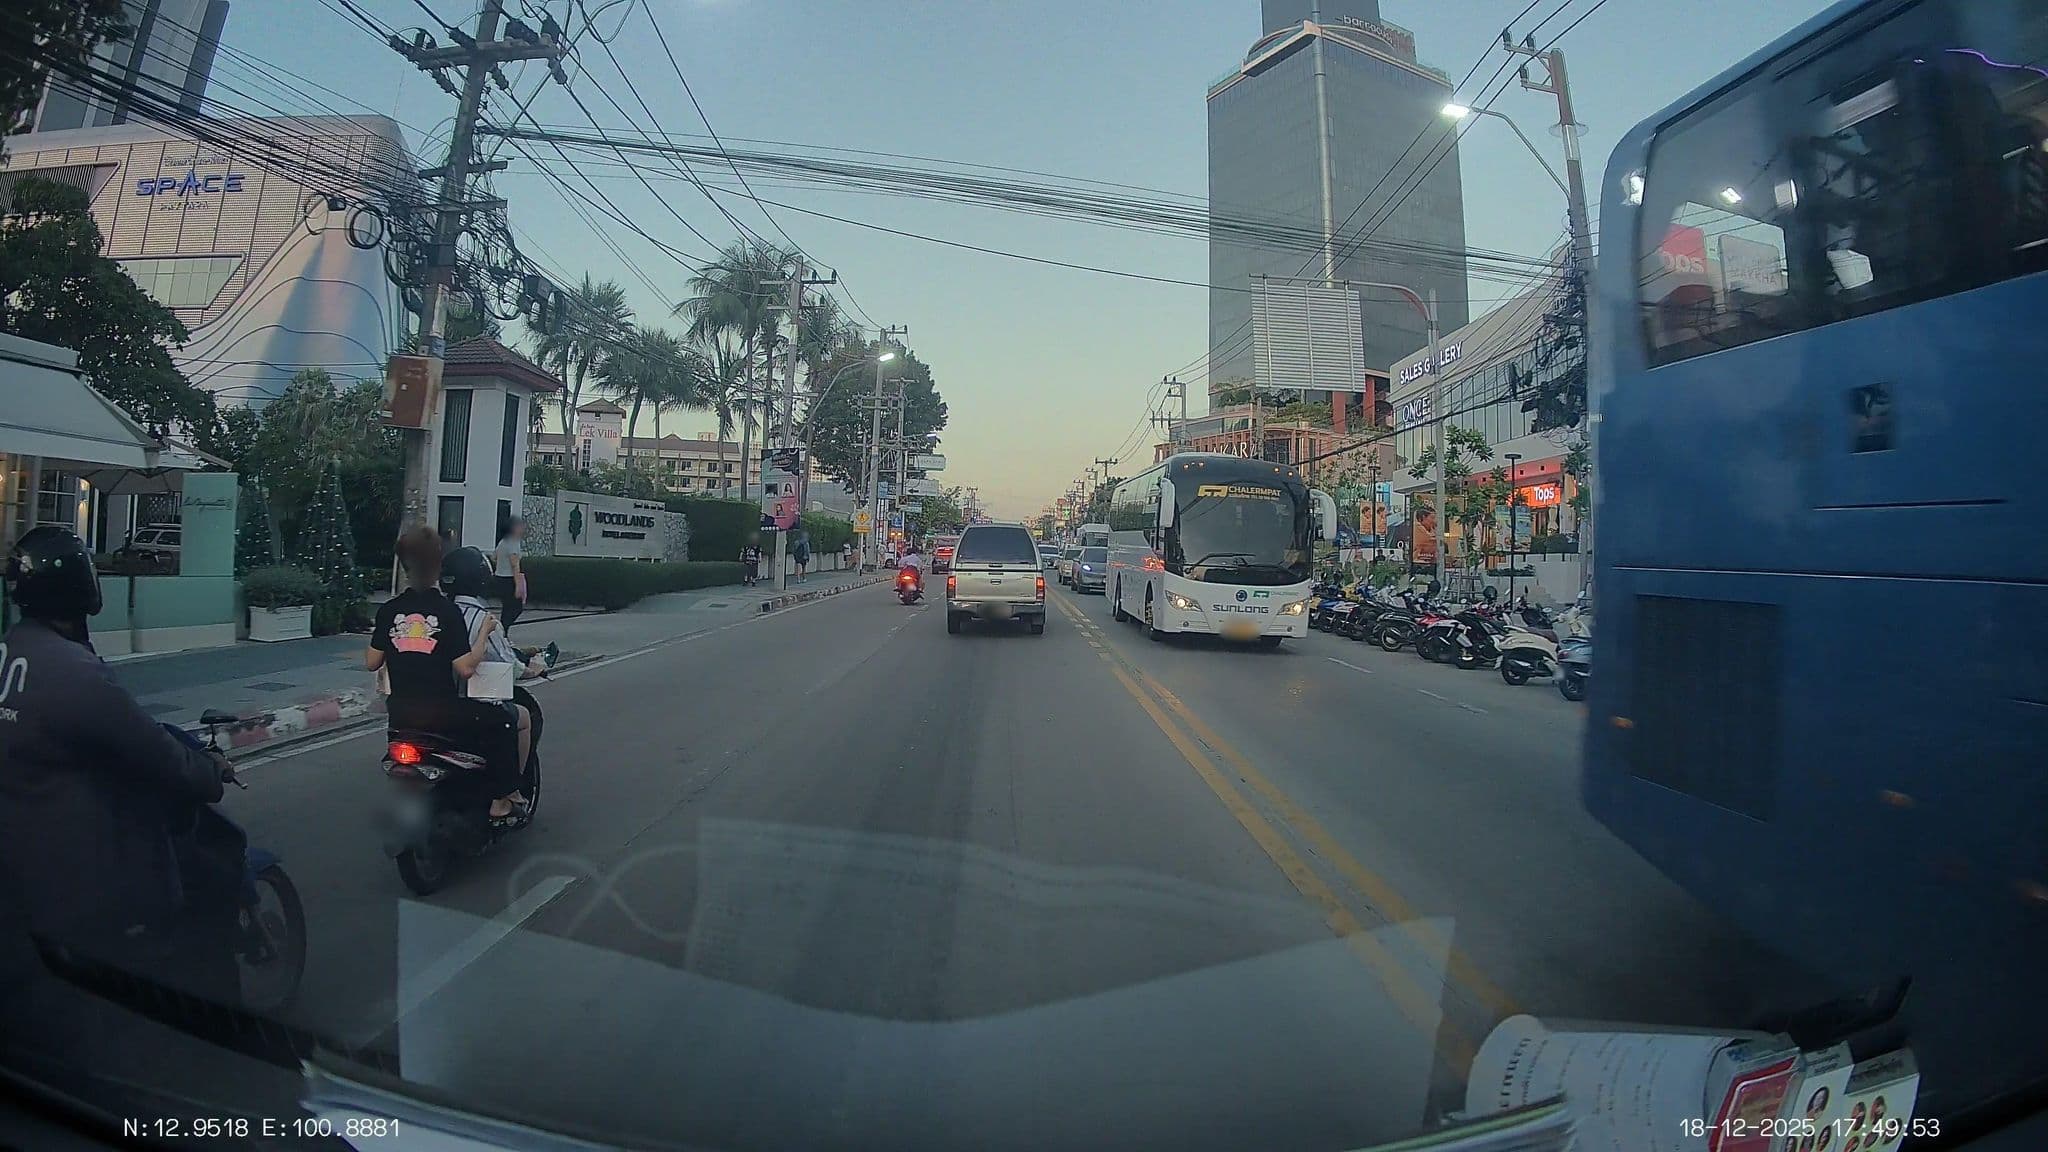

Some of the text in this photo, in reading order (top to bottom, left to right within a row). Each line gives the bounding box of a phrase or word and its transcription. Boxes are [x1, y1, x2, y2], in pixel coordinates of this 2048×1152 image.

[136, 169, 245, 197] SPACE
[1400, 341, 1463, 385] SALES GLERY
[1402, 396, 1431, 423] ONCE
[1228, 485, 1281, 497] CHALERMPAT
[1533, 486, 1555, 504] Tops
[594, 511, 655, 528] WOODLANDS
